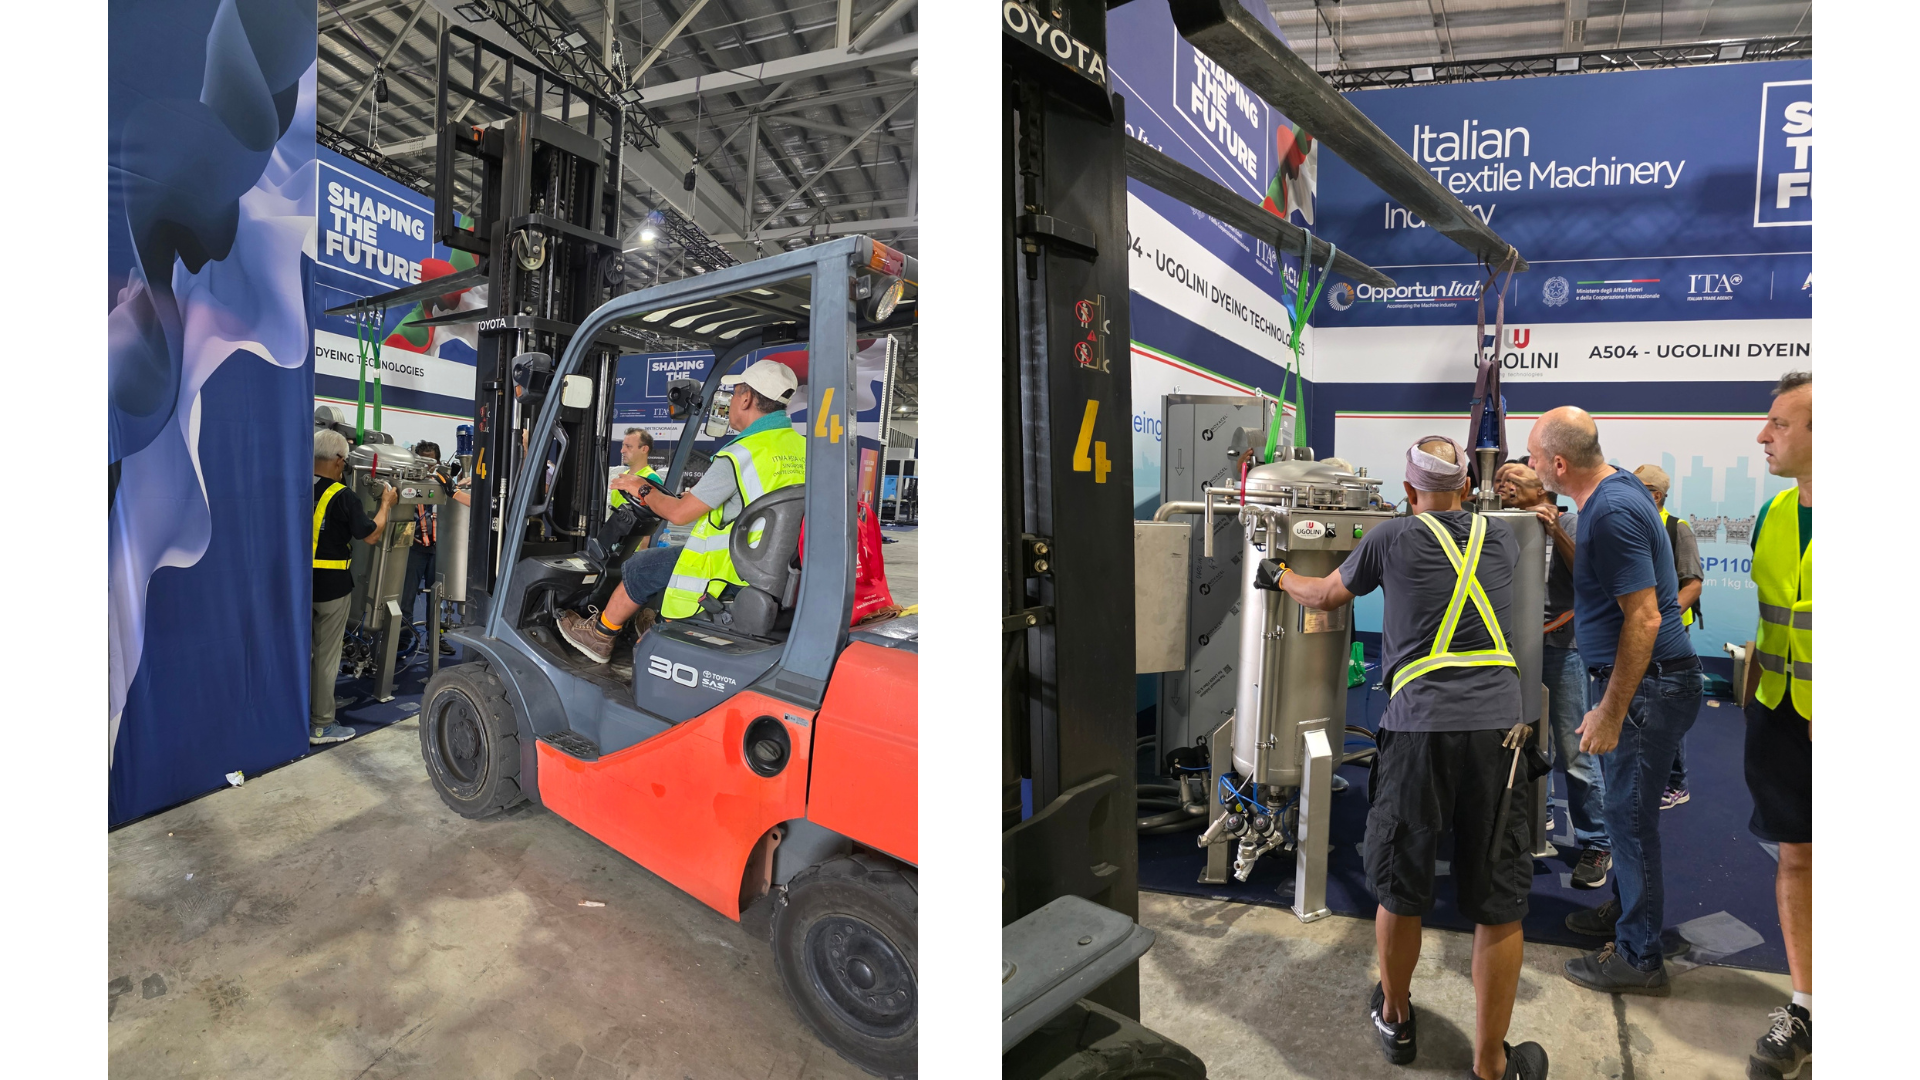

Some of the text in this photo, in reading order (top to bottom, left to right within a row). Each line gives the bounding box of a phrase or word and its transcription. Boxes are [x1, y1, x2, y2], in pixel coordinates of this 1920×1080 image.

[1194, 54, 1228, 119] THE
[1191, 81, 1257, 180] FUTURE
[1412, 119, 1530, 163] Italian
[1430, 156, 1686, 194] Textile Machinery
[1775, 171, 1813, 209] F
[327, 181, 425, 241] SHAPING
[329, 205, 378, 246] THE
[326, 229, 423, 285] FUTURE
[1155, 249, 1208, 299] UGOLINI
[1211, 285, 1248, 322] DYEING
[1600, 287, 1613, 295] degli
[1687, 273, 1734, 294] ITA
[478, 317, 507, 331] TOYOTA
[315, 346, 425, 377] DYEING TECNOLOGIES
[651, 360, 704, 372] SHAPING
[1588, 344, 1639, 360] A504
[1656, 343, 1741, 359] UGOLINI
[1747, 342, 1812, 357] DYEIN
[814, 387, 844, 444] 4
[1073, 399, 1112, 484] 4
[475, 447, 487, 479] 4
[1721, 577, 1741, 590] 1kg
[647, 654, 699, 688] 30
[701, 678, 725, 690] SAS
[712, 673, 737, 686] TOYOTA
